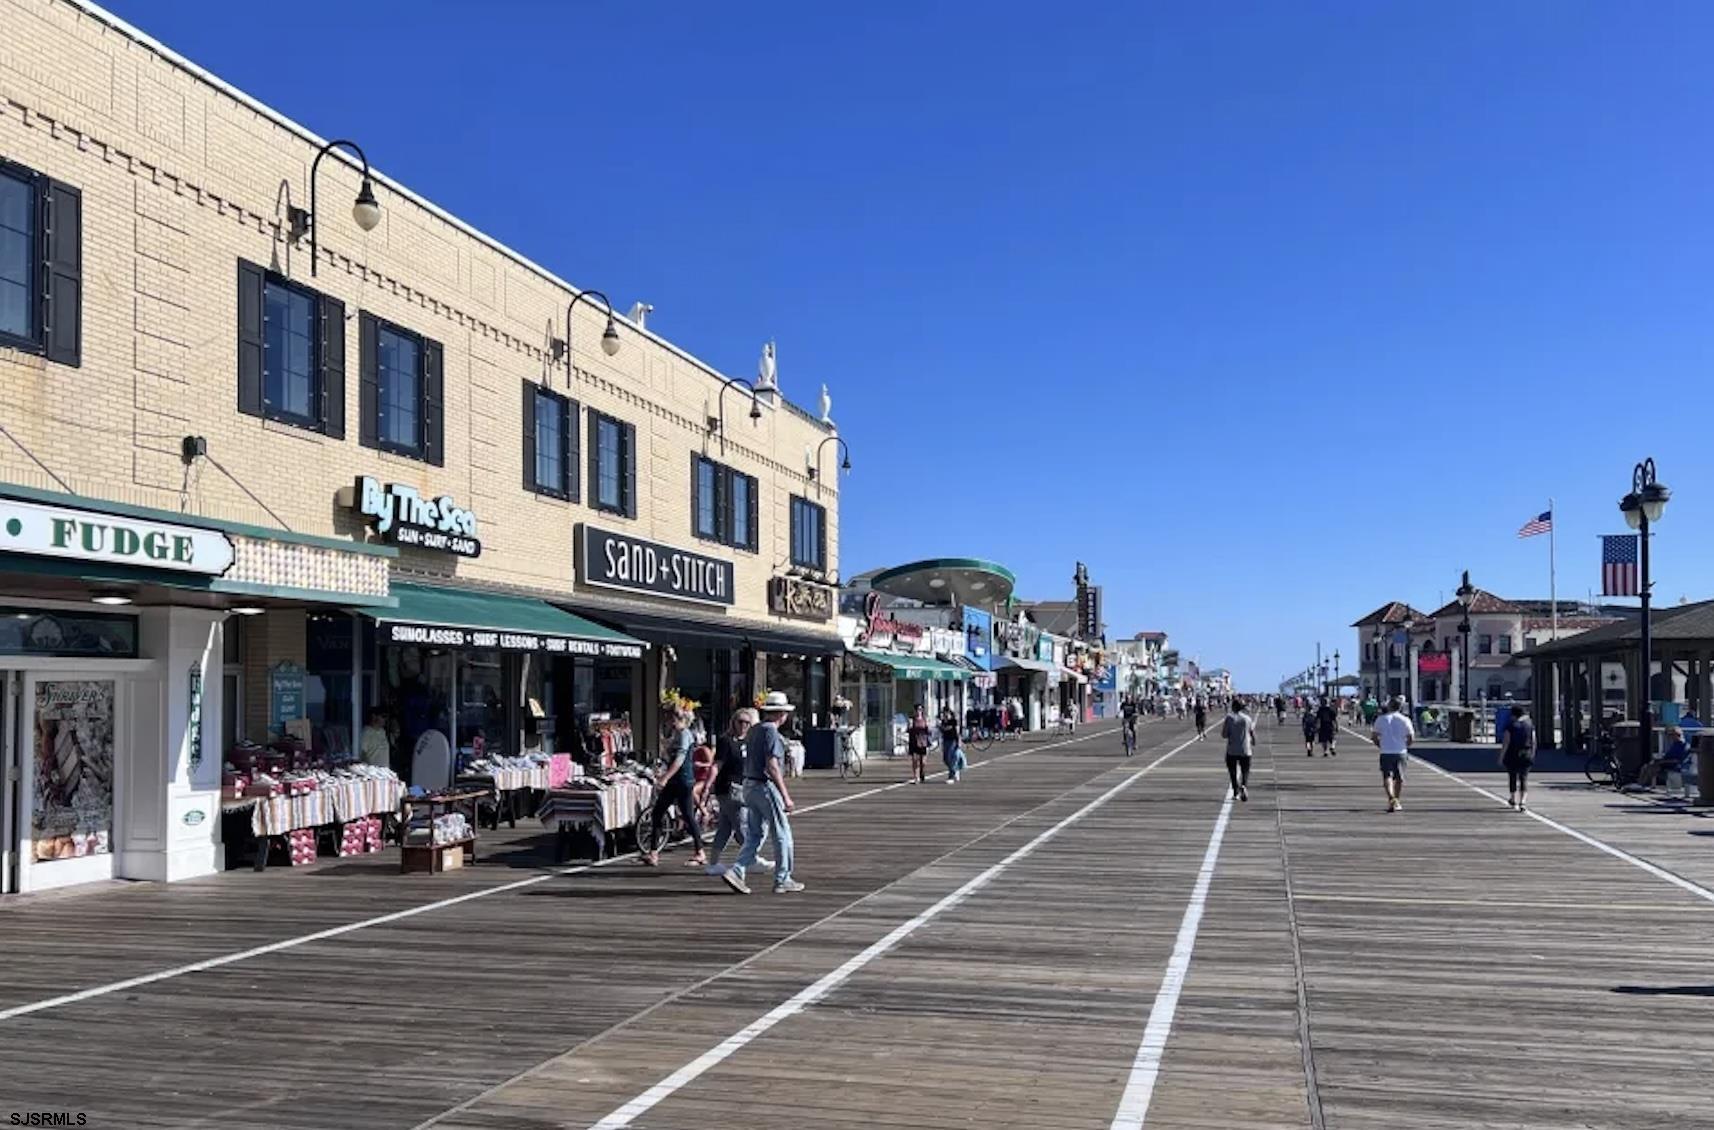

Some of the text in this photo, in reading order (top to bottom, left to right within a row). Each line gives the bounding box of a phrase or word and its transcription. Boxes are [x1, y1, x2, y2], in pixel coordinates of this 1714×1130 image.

[361, 476, 476, 537] By The Sea
[50, 517, 195, 565] FUDGE
[397, 527, 419, 543] SUN
[451, 537, 476, 554] SAND
[671, 553, 726, 597] STITCH
[391, 625, 464, 645] SUNGLASSES
[472, 632, 499, 648] SURF
[500, 633, 539, 649] LESSONS
[568, 640, 600, 655] RENTALS
